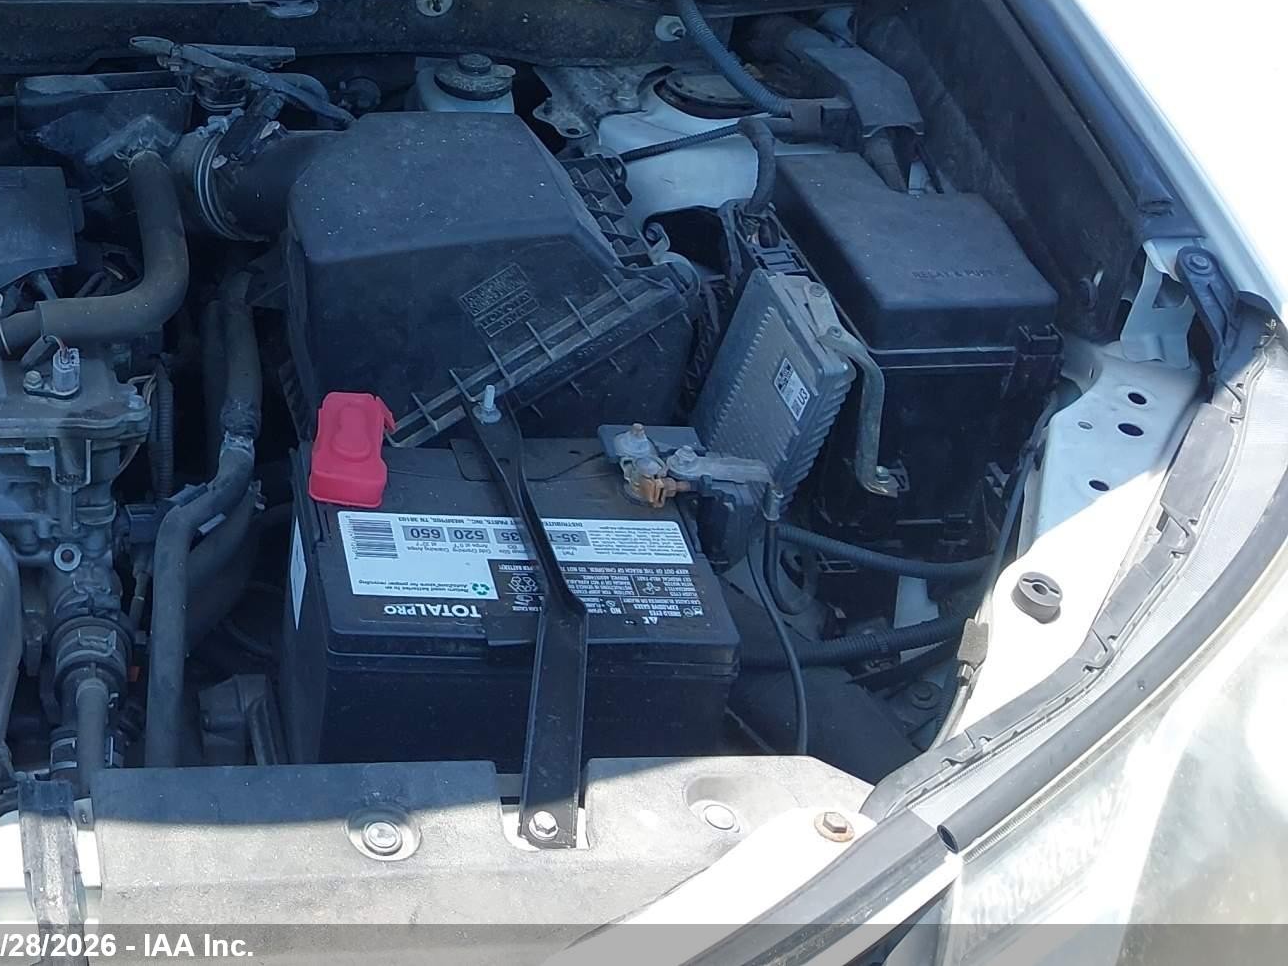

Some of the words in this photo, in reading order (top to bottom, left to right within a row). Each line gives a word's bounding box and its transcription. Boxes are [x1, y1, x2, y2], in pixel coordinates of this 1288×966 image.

[543, 520, 583, 528] DISTRIBUTE
[410, 527, 442, 539] 650
[453, 529, 485, 541] 520
[384, 603, 482, 618] TOTALPRO
